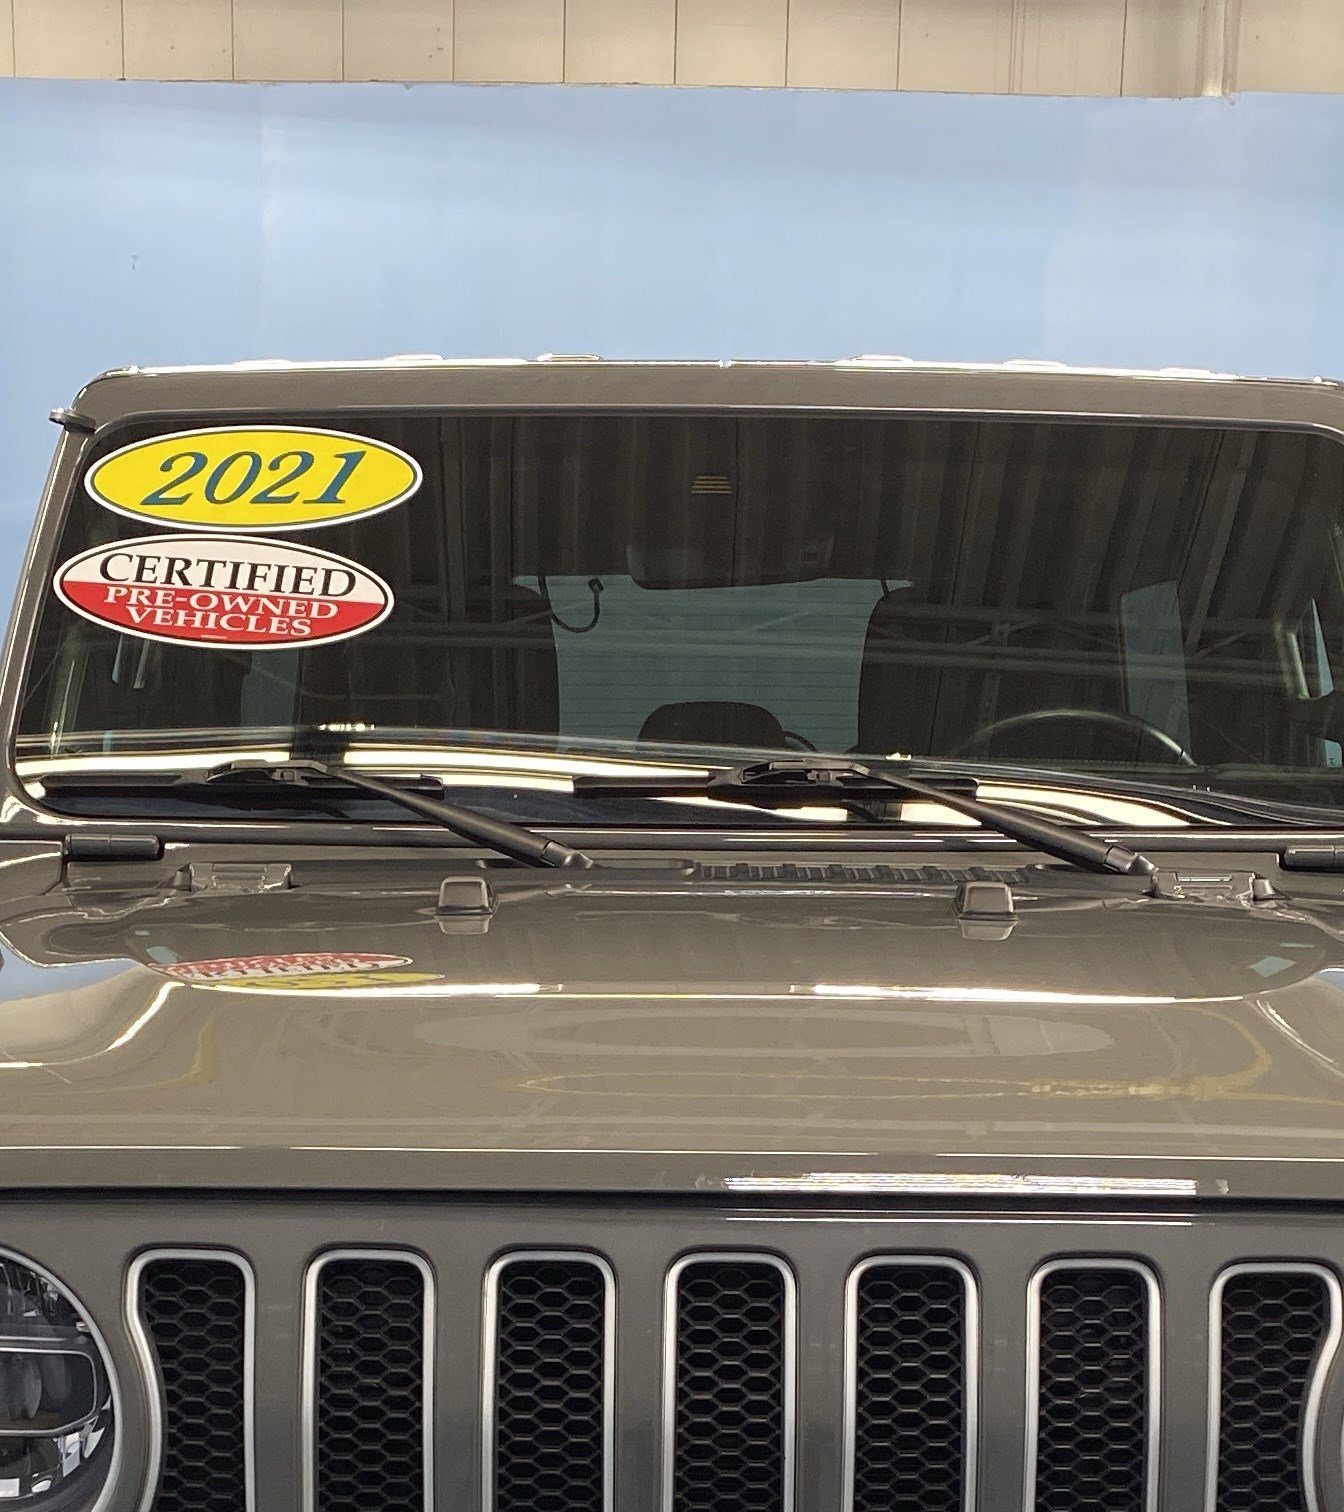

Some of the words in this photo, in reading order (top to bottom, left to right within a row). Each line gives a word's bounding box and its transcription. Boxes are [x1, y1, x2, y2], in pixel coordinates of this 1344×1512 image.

[140, 450, 367, 505] 2021
[99, 552, 356, 598] CERTIFIED
[104, 586, 338, 618] PRE-OWNED
[127, 605, 312, 637] VEHICLES
